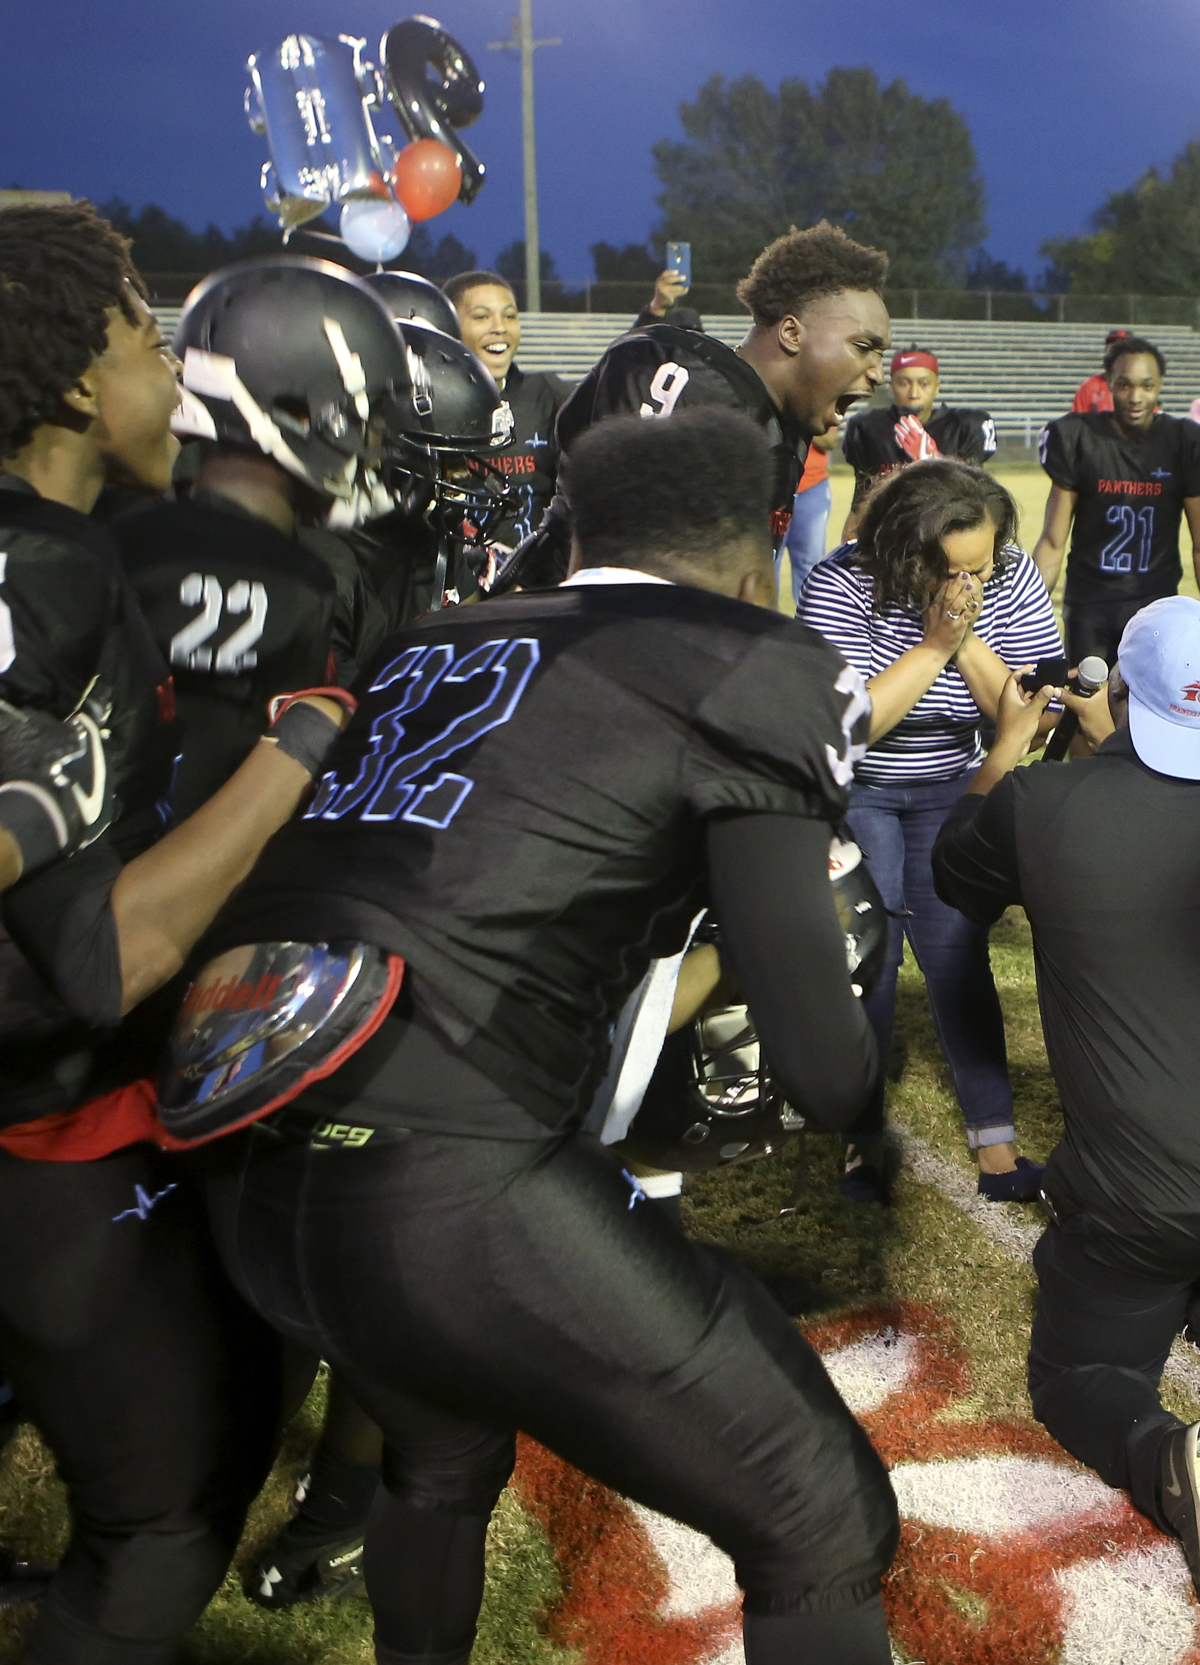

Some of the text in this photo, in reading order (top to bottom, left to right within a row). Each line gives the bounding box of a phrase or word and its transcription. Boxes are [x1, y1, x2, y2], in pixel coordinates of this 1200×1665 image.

[639, 361, 690, 420] 9
[1097, 478, 1163, 496] PANTHERS
[1100, 504, 1155, 573] 21
[170, 572, 268, 677] 22
[302, 637, 541, 829] 32
